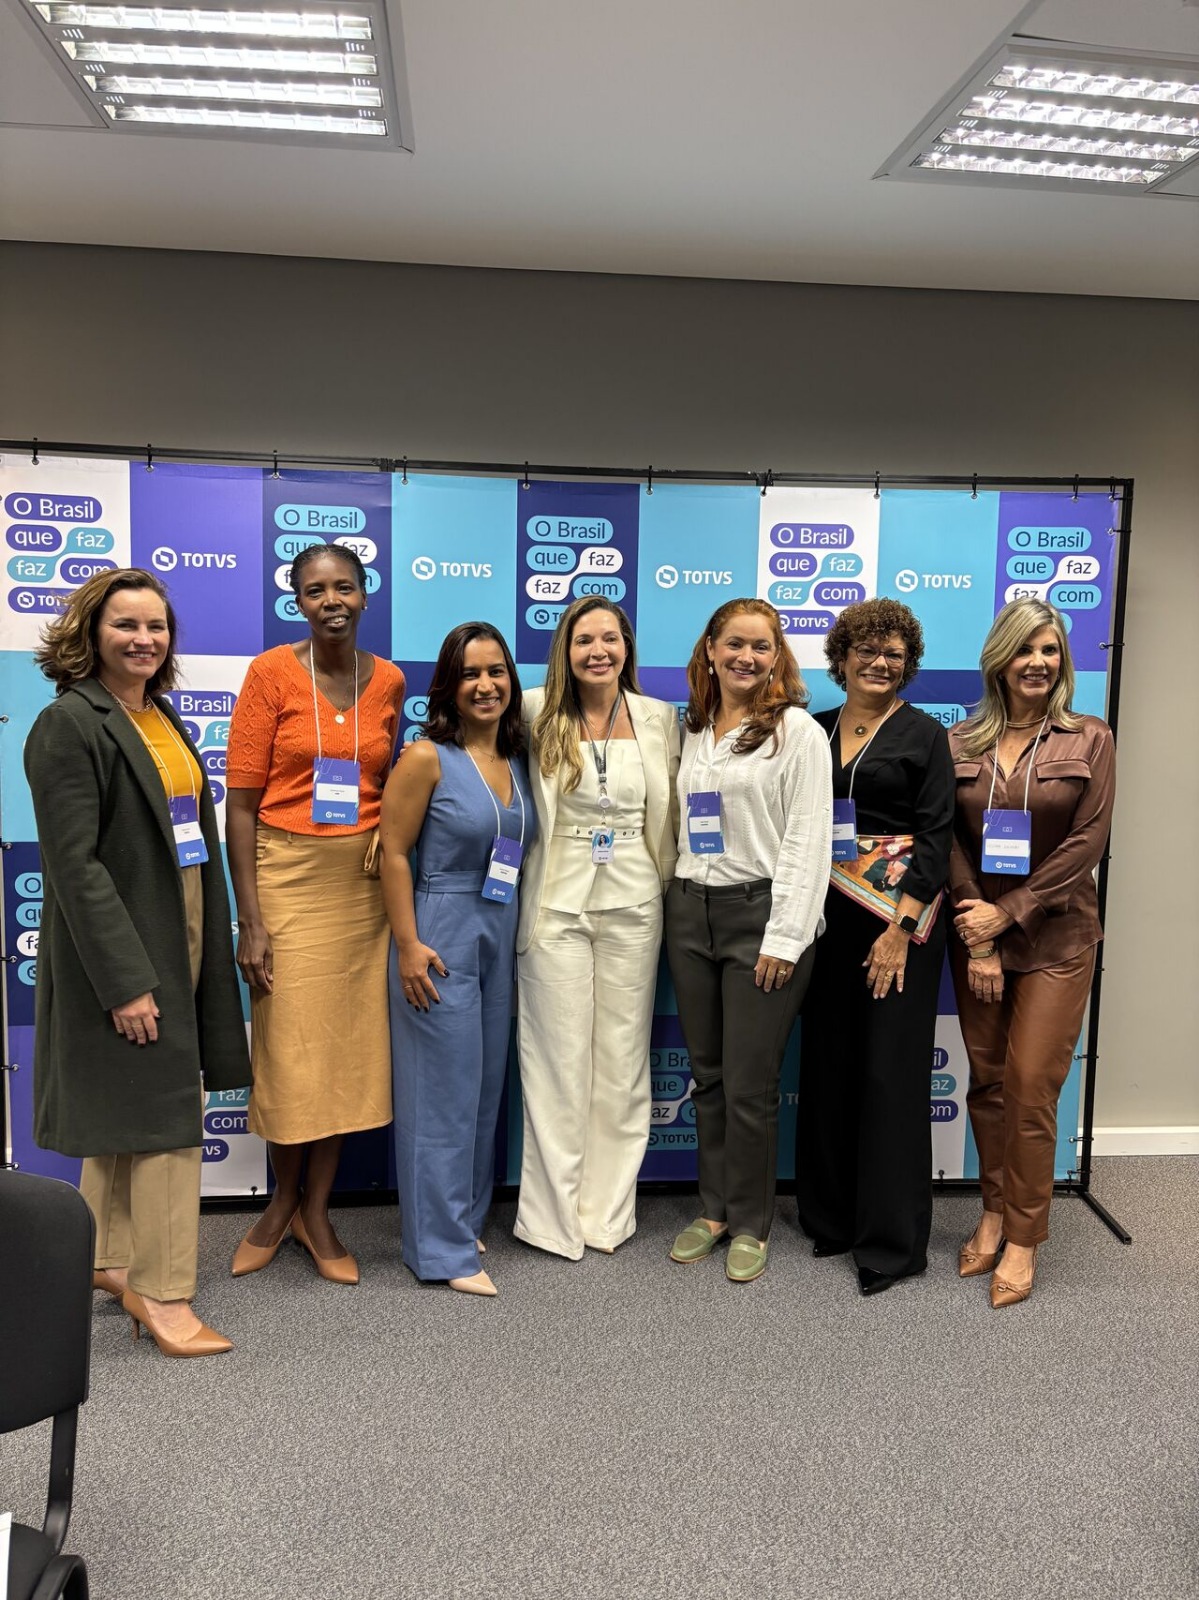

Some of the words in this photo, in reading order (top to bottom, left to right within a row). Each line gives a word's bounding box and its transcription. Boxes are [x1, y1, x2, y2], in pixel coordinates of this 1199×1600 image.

[13, 497, 32, 515] O
[40, 498, 94, 519] Brasil
[283, 509, 300, 526] O
[308, 510, 358, 529] Brasil
[535, 520, 551, 537] O
[558, 521, 605, 539] Brasil
[777, 527, 793, 543] O
[800, 528, 847, 545] Brasil
[15, 530, 53, 547] que
[76, 532, 106, 549] faz
[1015, 531, 1031, 547] O
[1038, 531, 1084, 548] Brasil
[283, 540, 317, 556] qu
[342, 541, 368, 557] az
[181, 552, 237, 569] TOTVS
[534, 551, 568, 566] que
[588, 551, 614, 567] faz
[776, 557, 810, 573] que
[829, 557, 856, 572] faz
[16, 561, 47, 577] faz
[440, 562, 492, 578] TOTVS
[1014, 560, 1047, 575] que
[1066, 560, 1092, 575] faz
[682, 570, 733, 585] TOTVS
[922, 574, 972, 589] TOTVS
[534, 579, 561, 594] faz
[581, 582, 618, 596] com
[775, 585, 802, 600] faz
[821, 587, 858, 600] com
[1057, 589, 1094, 603] com
[792, 617, 829, 628] TOTVS
[180, 695, 232, 713] Brasil
[412, 701, 428, 717] O
[206, 757, 226, 769] co
[24, 877, 41, 894] O
[932, 1079, 949, 1091] az
[652, 1106, 670, 1118] az
[662, 1134, 696, 1144] TOTVS
